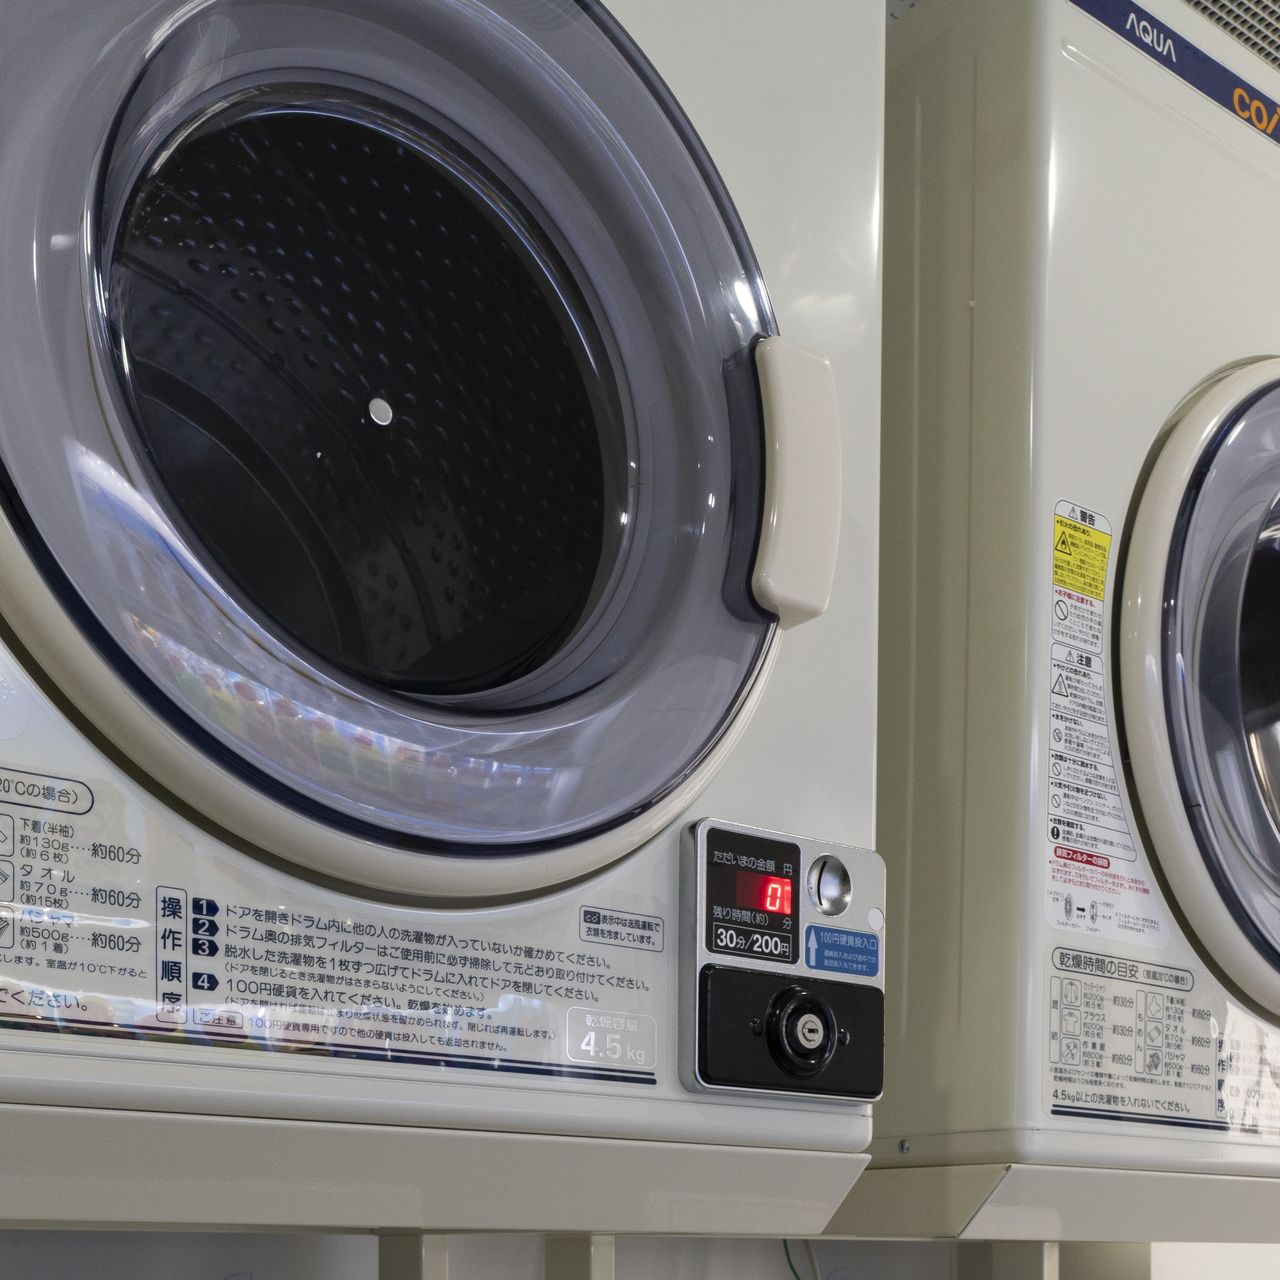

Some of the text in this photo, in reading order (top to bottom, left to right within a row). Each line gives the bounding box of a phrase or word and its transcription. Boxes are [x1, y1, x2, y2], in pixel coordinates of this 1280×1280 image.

[1126, 12, 1177, 63] AQUA
[20, 864, 75, 883] タオル
[713, 850, 793, 876] ただいまの金額 円
[783, 918, 793, 930] 分
[1059, 951, 1139, 980] 乾燥時間の目安
